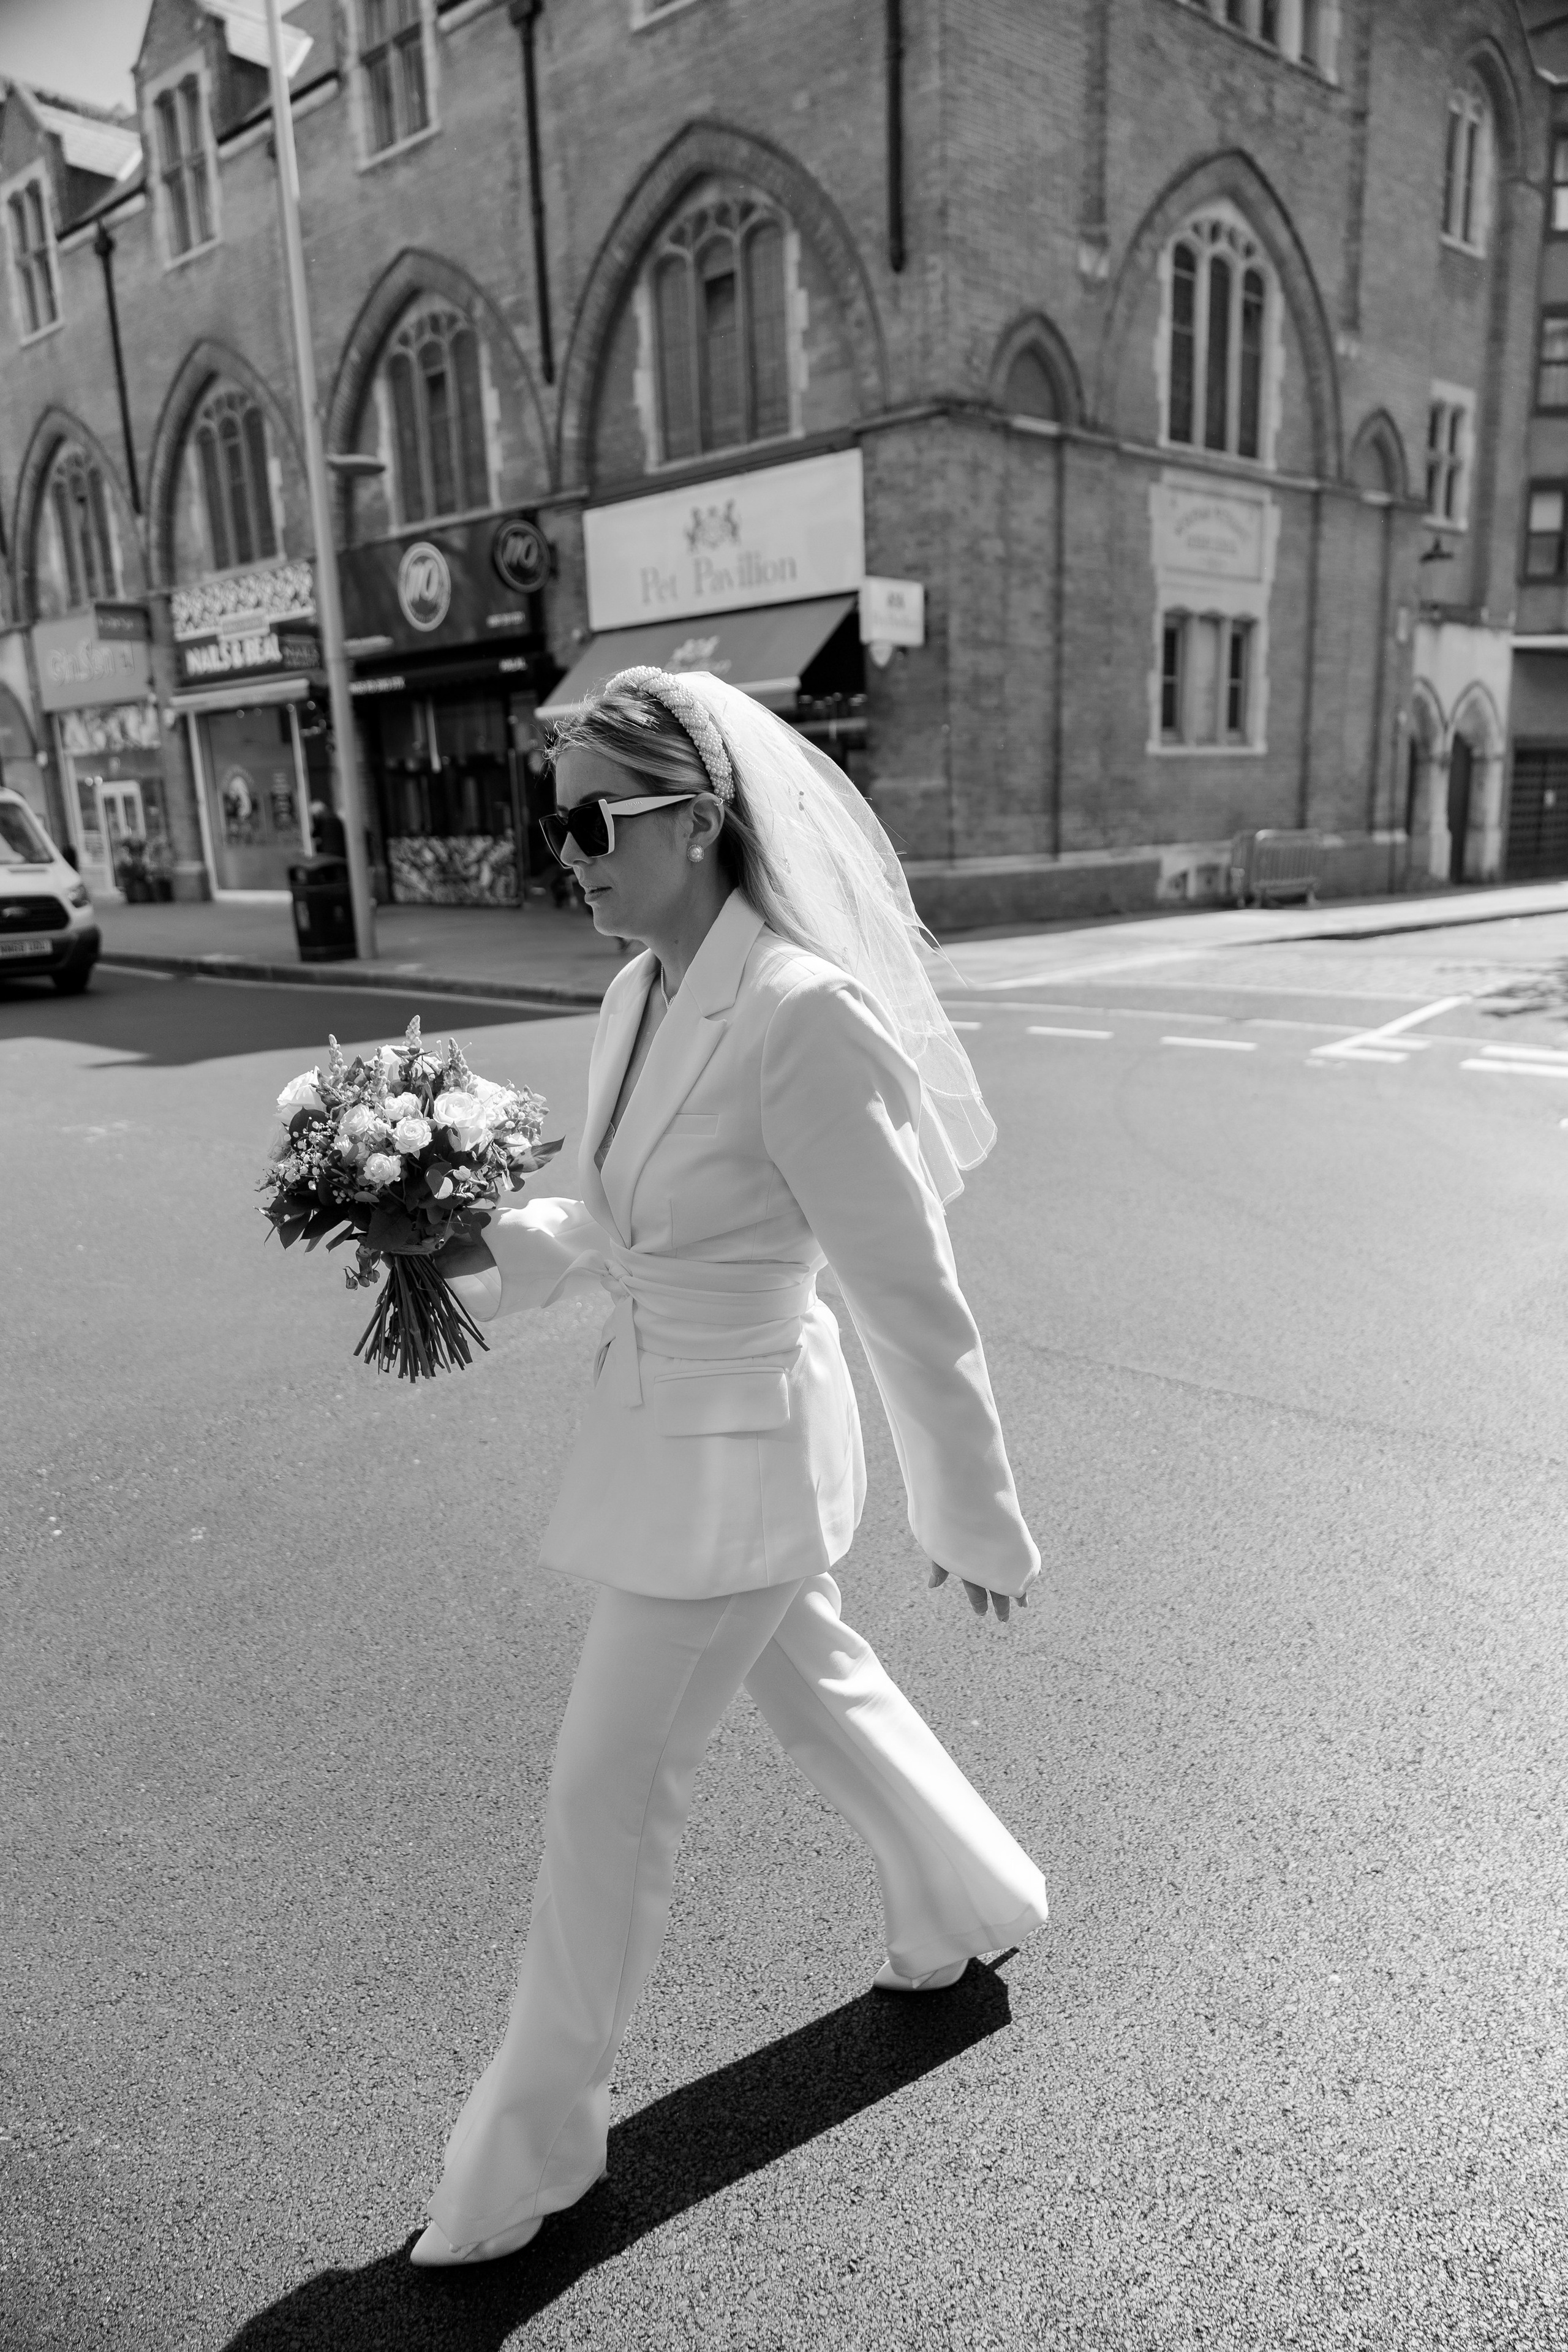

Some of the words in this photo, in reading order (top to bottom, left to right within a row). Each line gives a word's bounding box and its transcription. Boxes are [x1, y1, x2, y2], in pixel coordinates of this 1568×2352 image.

[640, 565, 679, 606] Pet
[693, 550, 798, 597] Pavilion
[186, 641, 232, 674] NAILS
